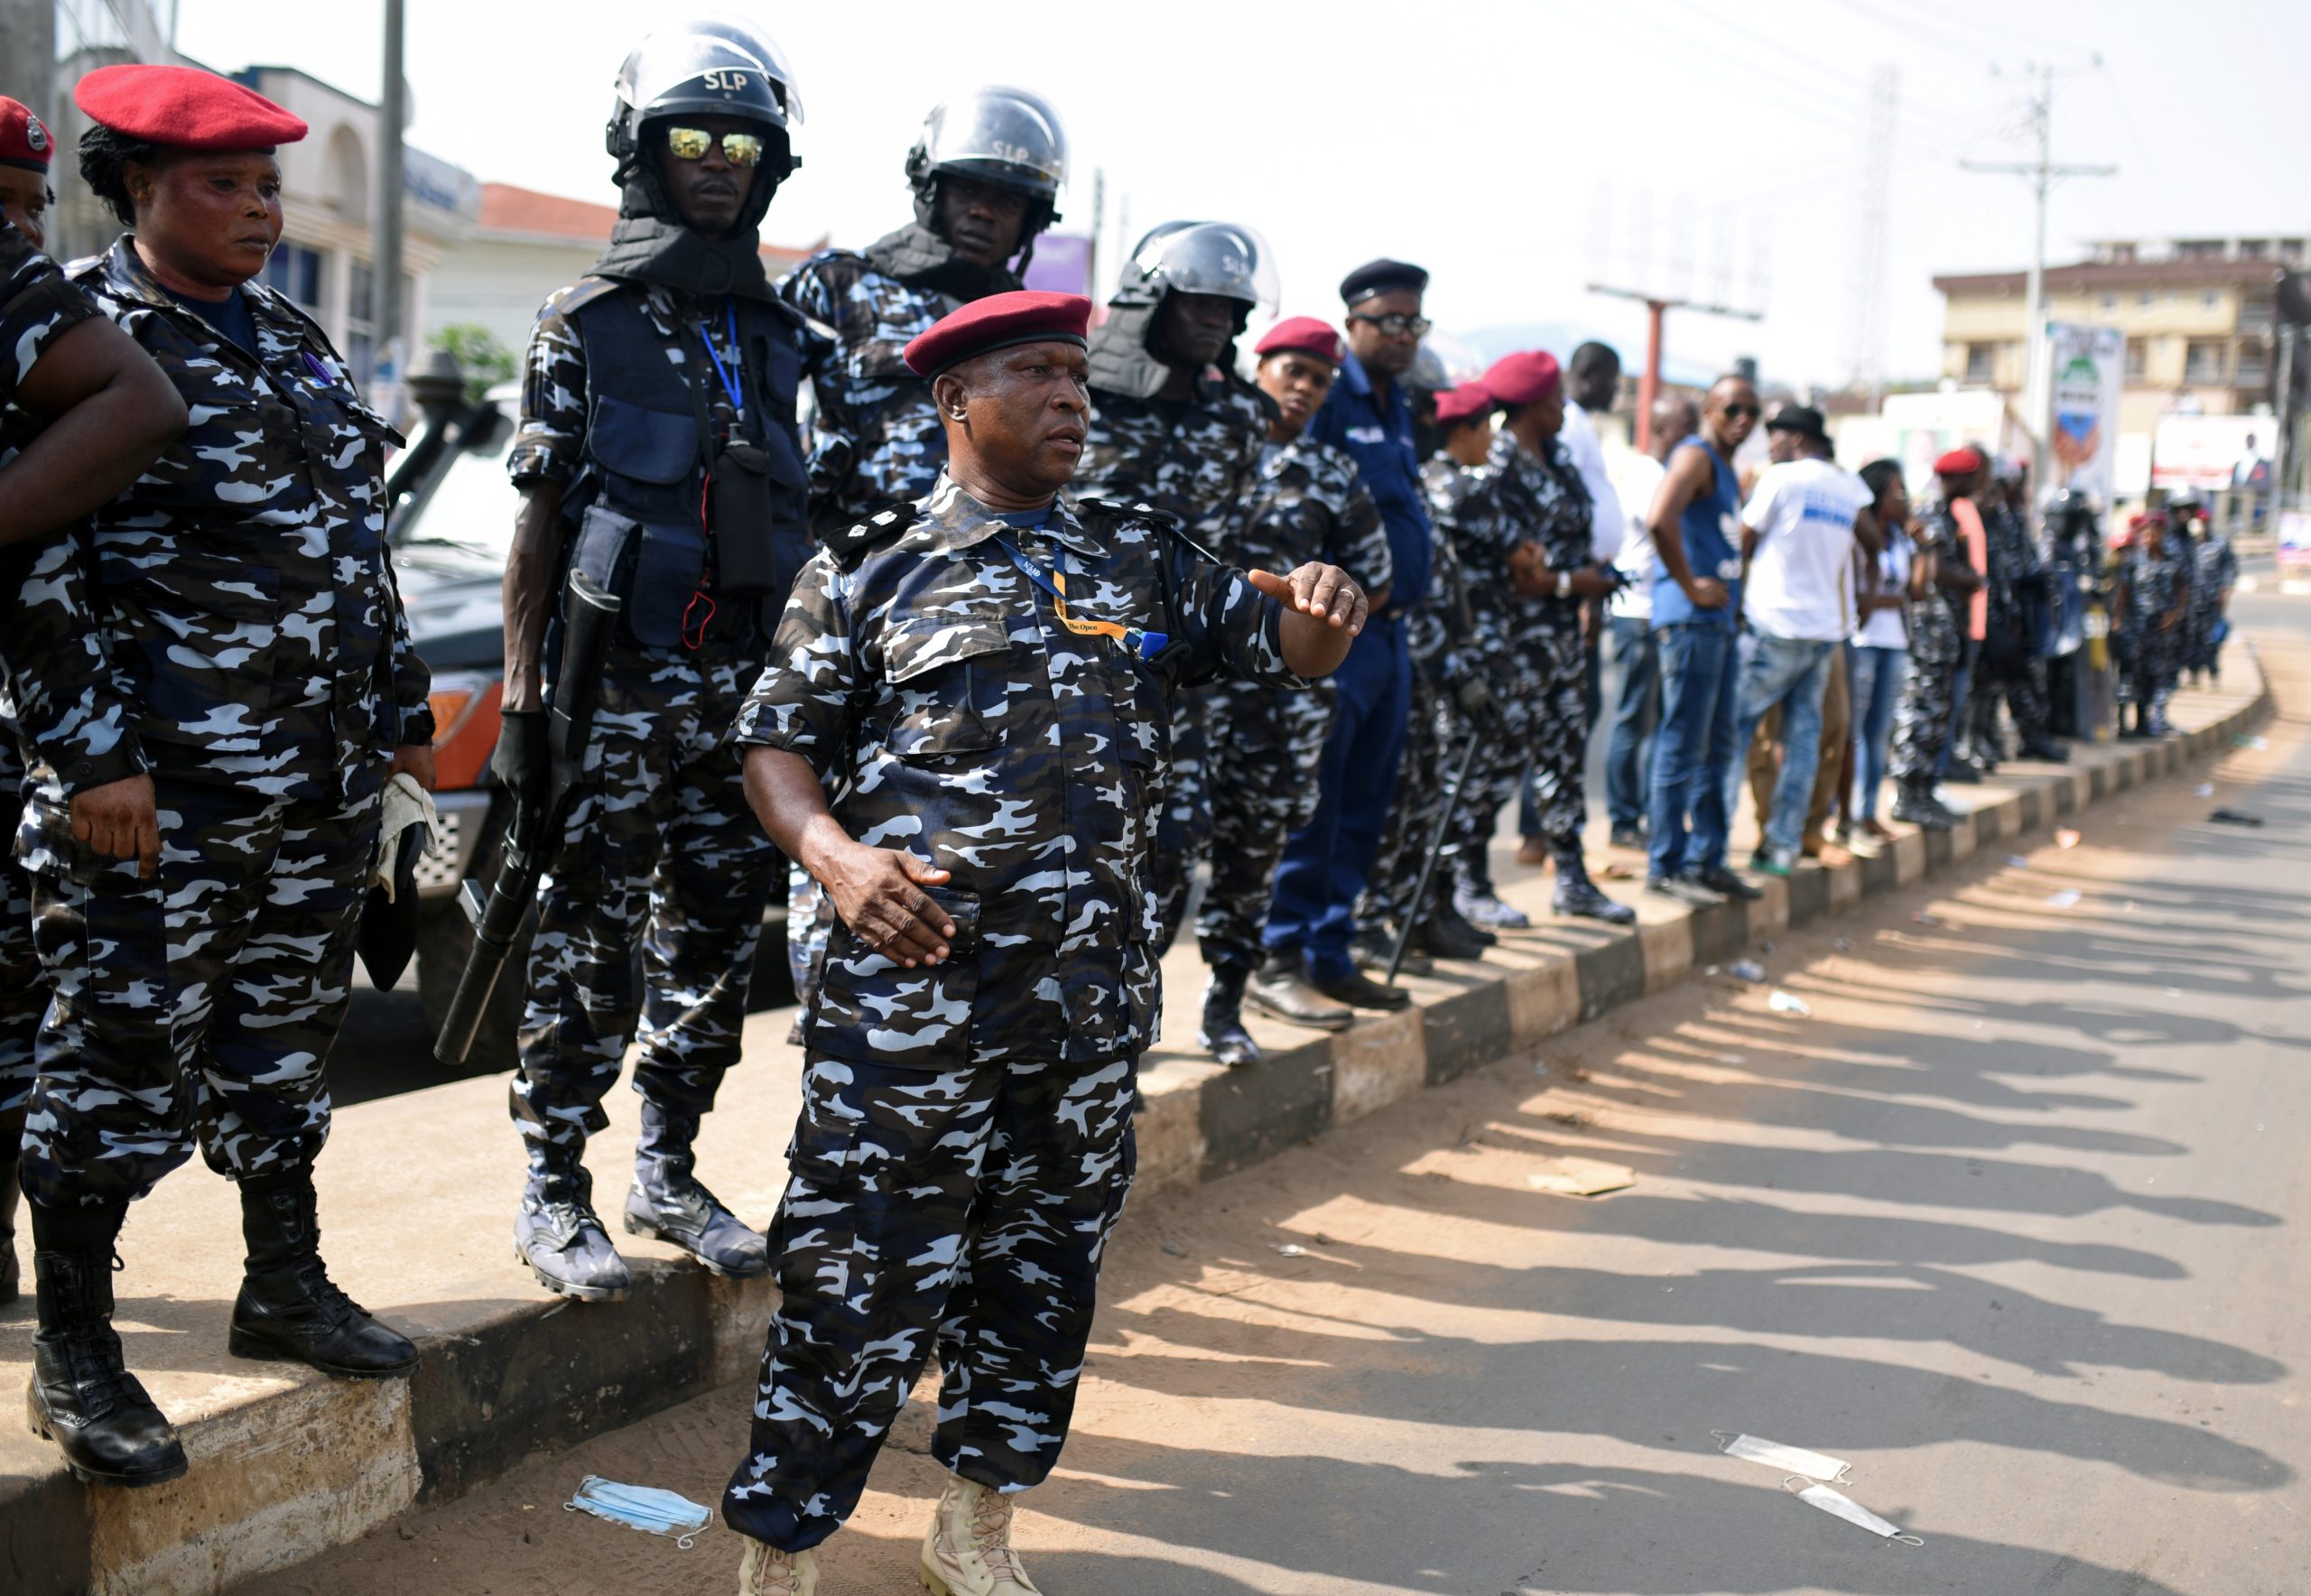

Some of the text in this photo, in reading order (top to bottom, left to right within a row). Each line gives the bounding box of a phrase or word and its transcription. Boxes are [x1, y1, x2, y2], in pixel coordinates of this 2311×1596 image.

[703, 71, 747, 91] SLP
[992, 141, 1029, 165] SLP
[1080, 624, 1098, 632] Open
